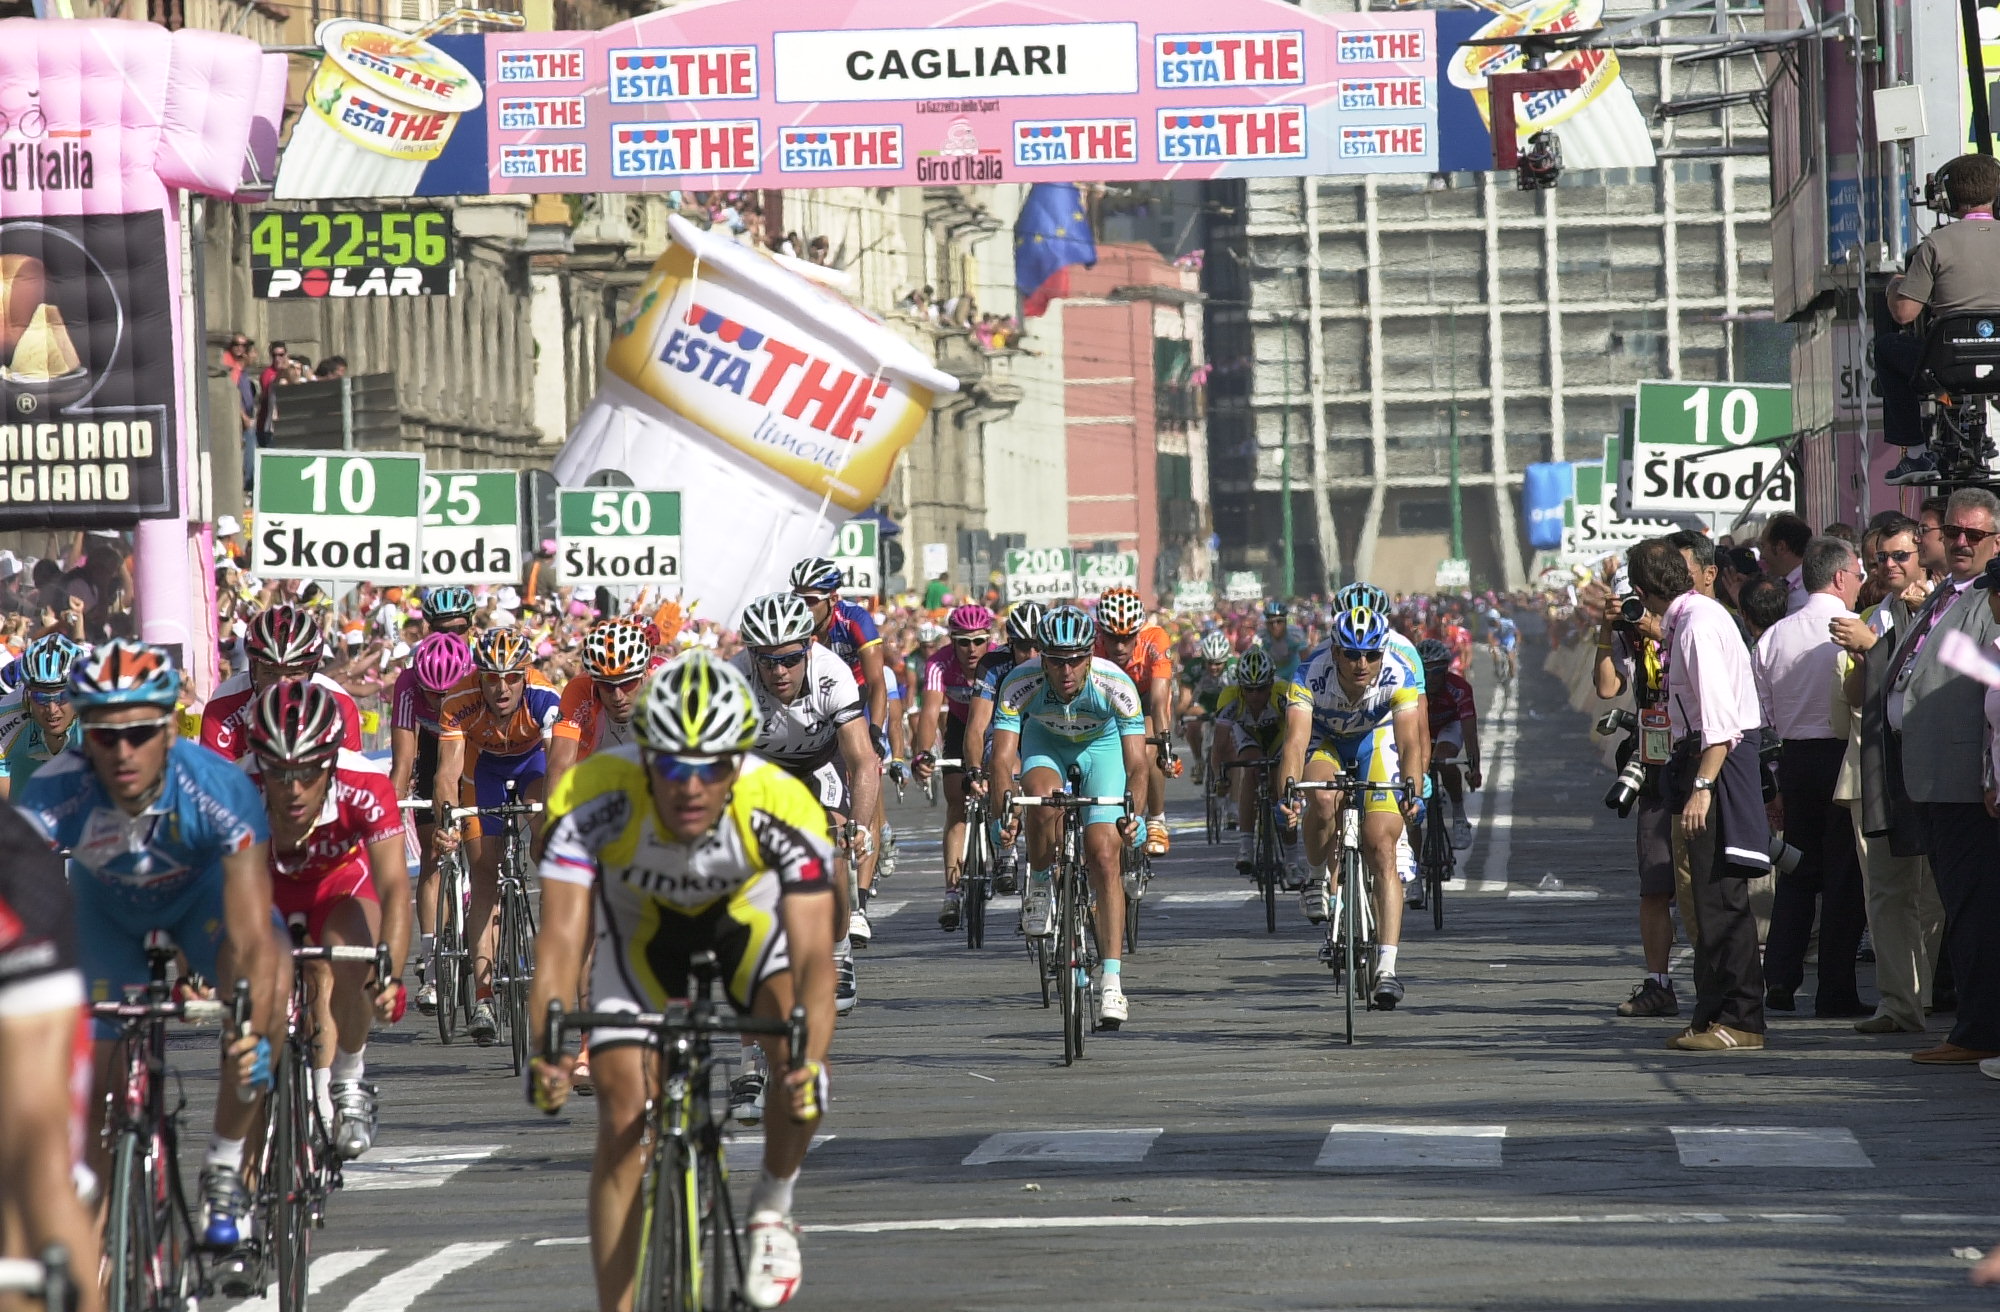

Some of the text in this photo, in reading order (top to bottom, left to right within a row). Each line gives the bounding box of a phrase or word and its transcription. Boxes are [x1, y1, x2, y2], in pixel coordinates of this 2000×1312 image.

[846, 45, 1067, 80] CAGLIARI
[917, 157, 949, 182] Giro
[251, 212, 447, 268] 4:22:56
[267, 267, 424, 298] POLAR
[1682, 388, 1759, 445] 10
[300, 457, 376, 514] 10
[424, 475, 481, 525] 25
[590, 492, 651, 535] 50
[263, 521, 410, 571] Škoda
[565, 542, 678, 578] Škoda
[1015, 550, 1064, 574] 200
[1086, 555, 1129, 578] 250
